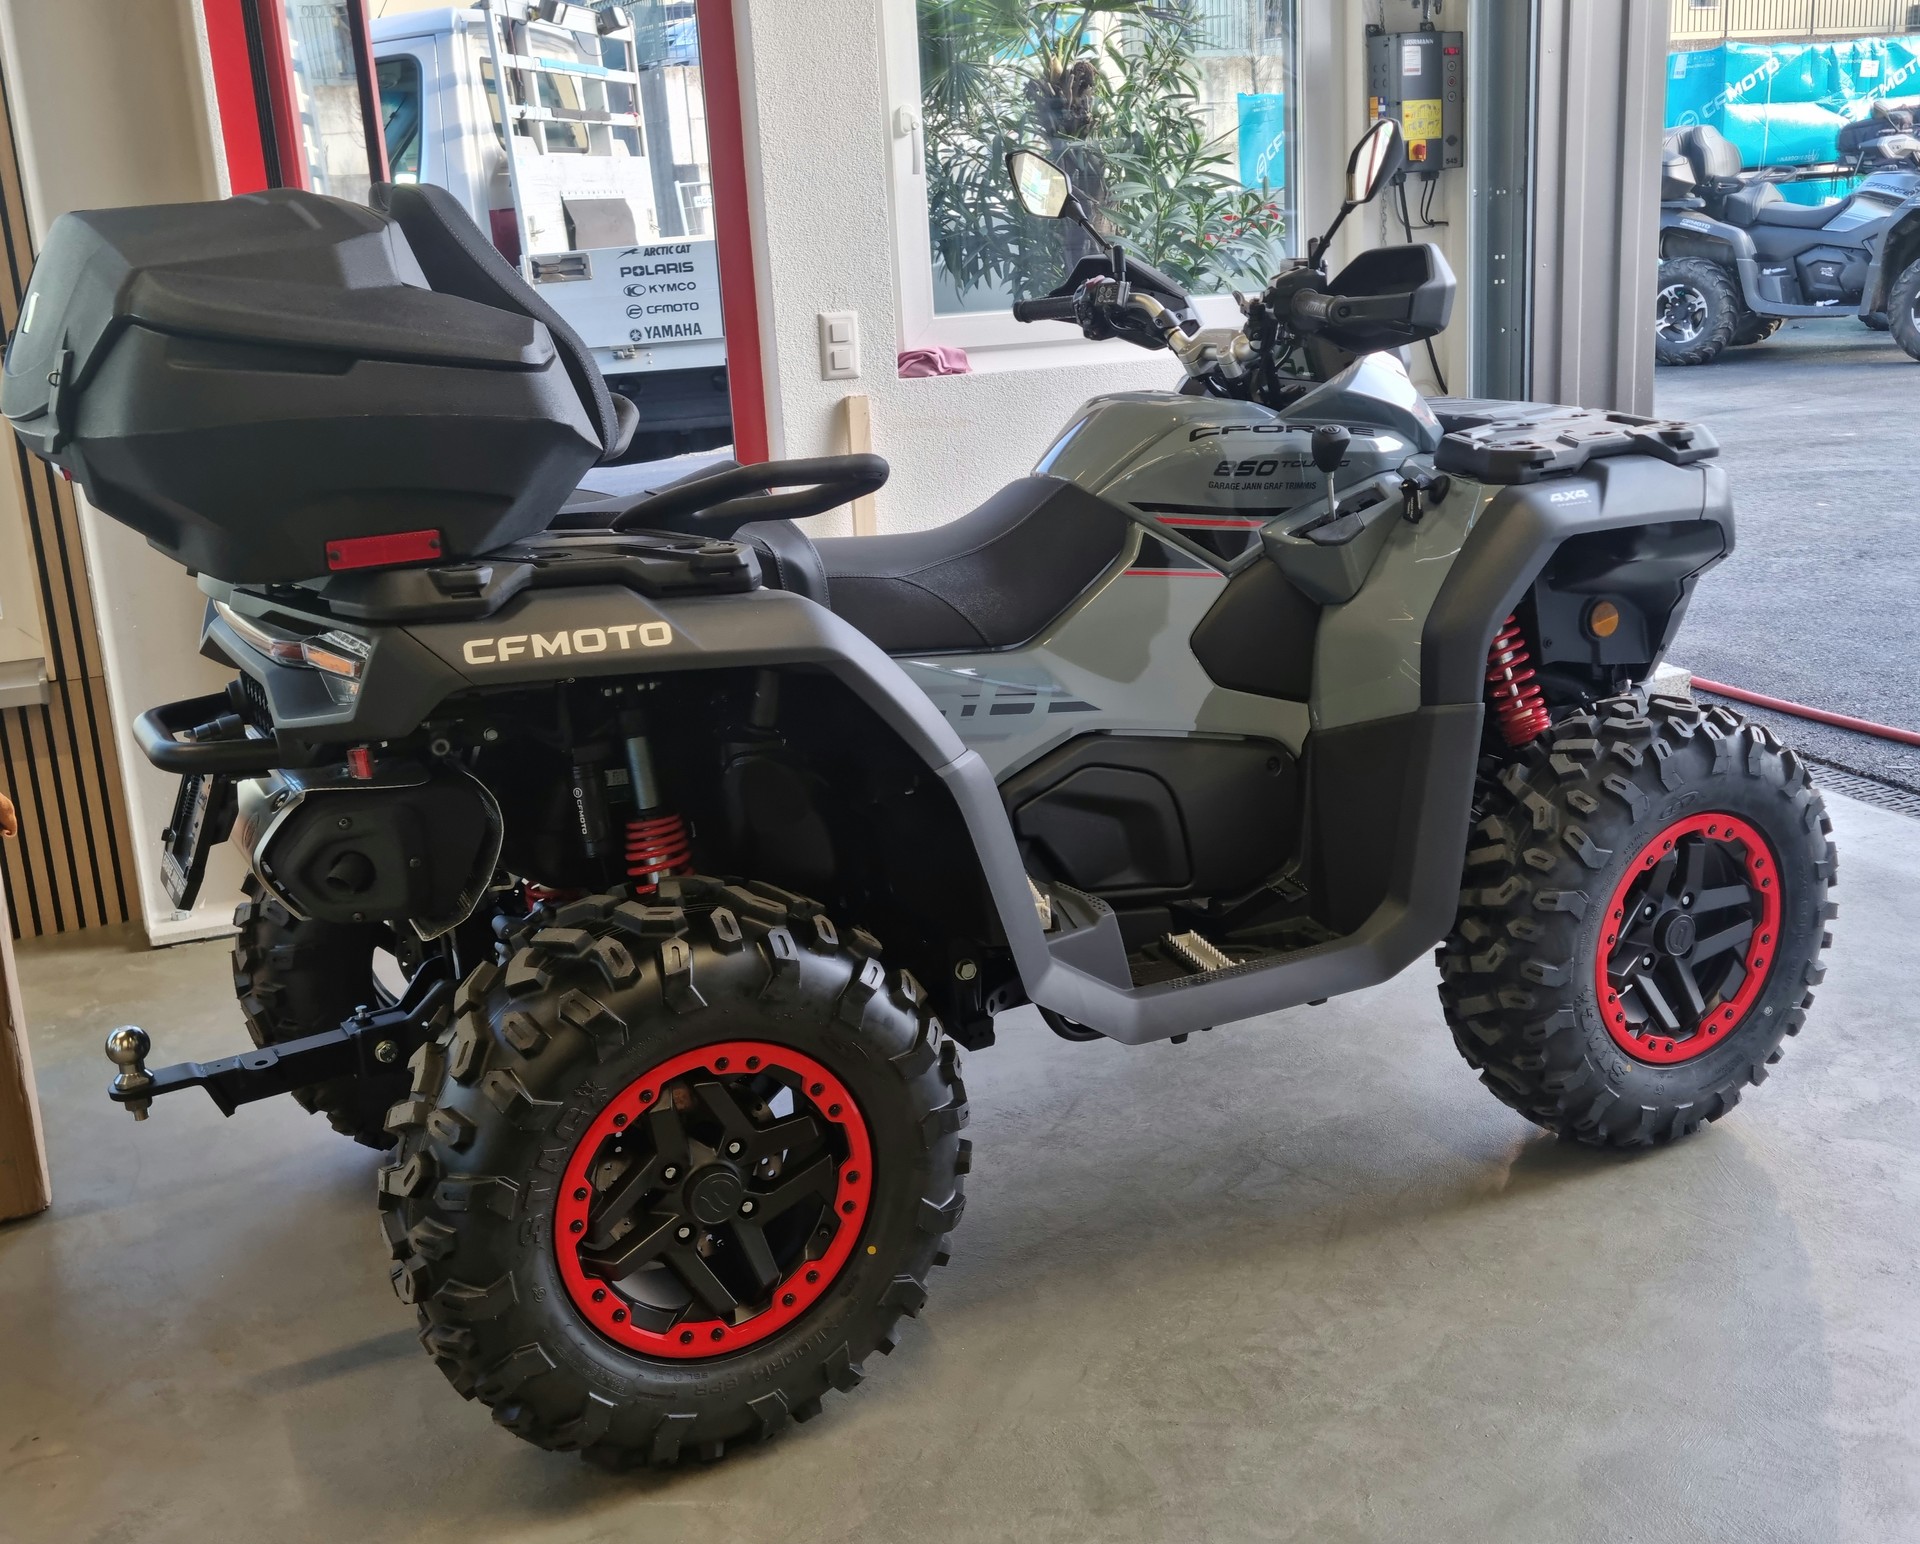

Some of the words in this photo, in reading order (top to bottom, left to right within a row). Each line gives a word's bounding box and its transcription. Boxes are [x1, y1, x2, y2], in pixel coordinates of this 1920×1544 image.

[643, 245, 674, 258] ARCTIC
[675, 243, 692, 255] CAT
[620, 261, 695, 278] POLARIS
[648, 281, 697, 294] KYMCO
[646, 301, 700, 315] CFMOTO
[644, 322, 702, 340] YAMAHA
[1189, 425, 1375, 442] CFORE
[1213, 460, 1279, 477] 850
[1208, 481, 1241, 491] GARAGE
[1242, 482, 1263, 491] JANN
[1264, 481, 1284, 490] GRAF
[1285, 481, 1317, 490] TRIMMIS
[463, 621, 673, 665] CFMOTO
[576, 799, 588, 835] CFMOTO
